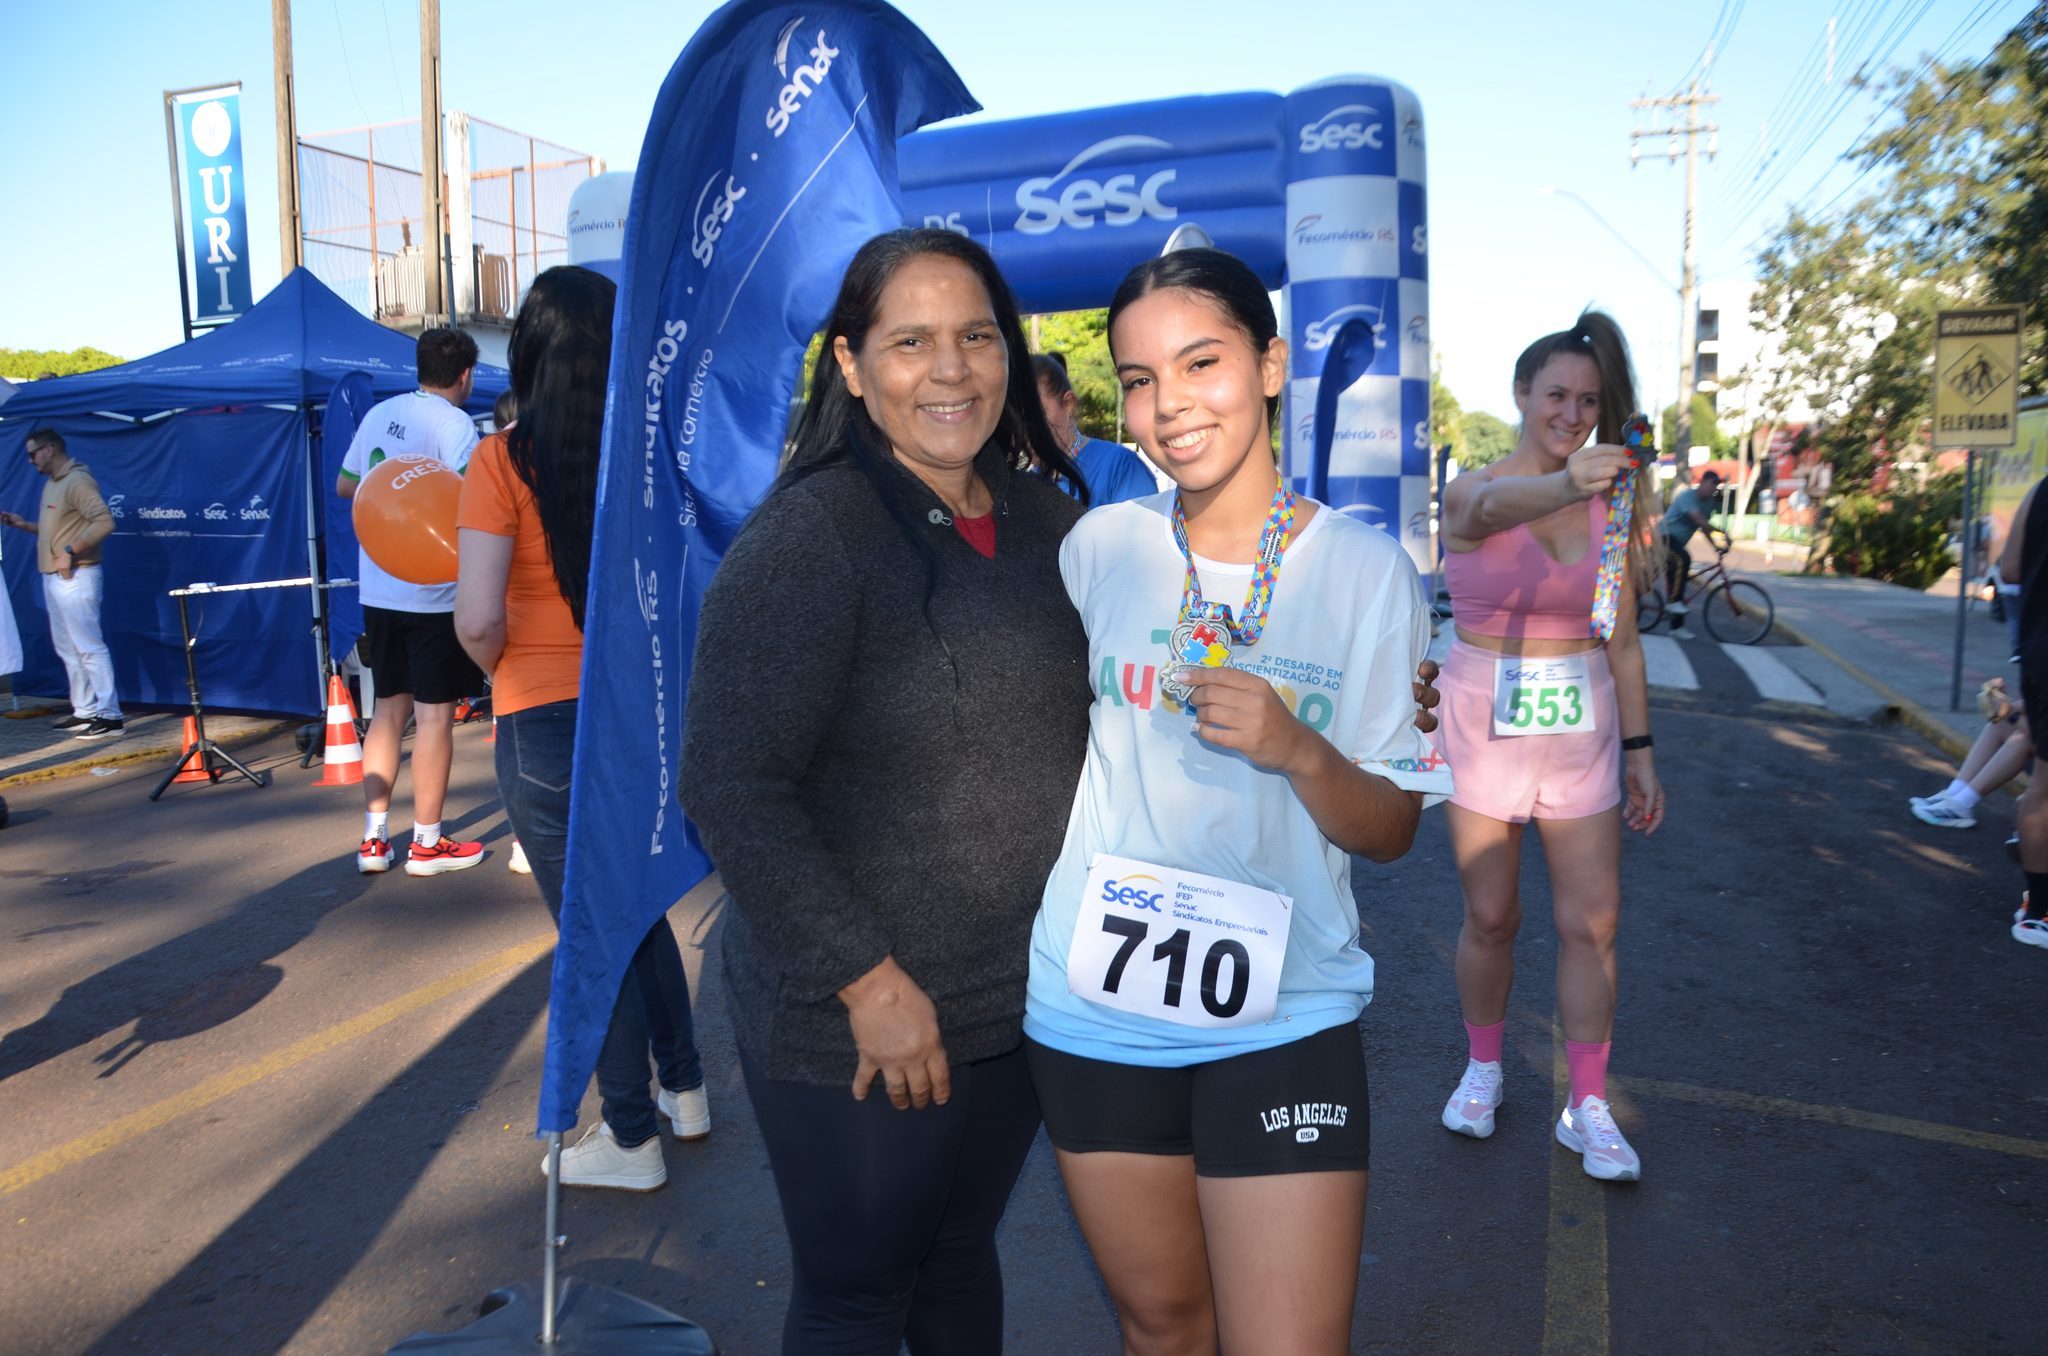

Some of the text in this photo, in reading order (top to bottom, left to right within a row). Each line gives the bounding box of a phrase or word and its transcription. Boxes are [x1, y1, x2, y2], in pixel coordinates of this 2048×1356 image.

[198, 165, 237, 311] URI
[138, 507, 187, 520] Sindicatos
[646, 570, 659, 622] RS
[1231, 661, 1340, 691] NSCIENTIZAÇÃO AO
[1275, 657, 1325, 675] DESAFIO
[1327, 668, 1343, 680] EM
[1509, 685, 1583, 728] 553
[650, 635, 669, 855] Fecomércio
[1175, 892, 1193, 901] IFEP
[1177, 882, 1225, 898] Fecomércio
[1174, 901, 1198, 912] Senac
[1172, 910, 1269, 937] Sindicatos Empresariais
[1101, 913, 1251, 1019] 710
[1260, 1103, 1348, 1133] LOS ANGELES
[1300, 1131, 1315, 1140] USA
